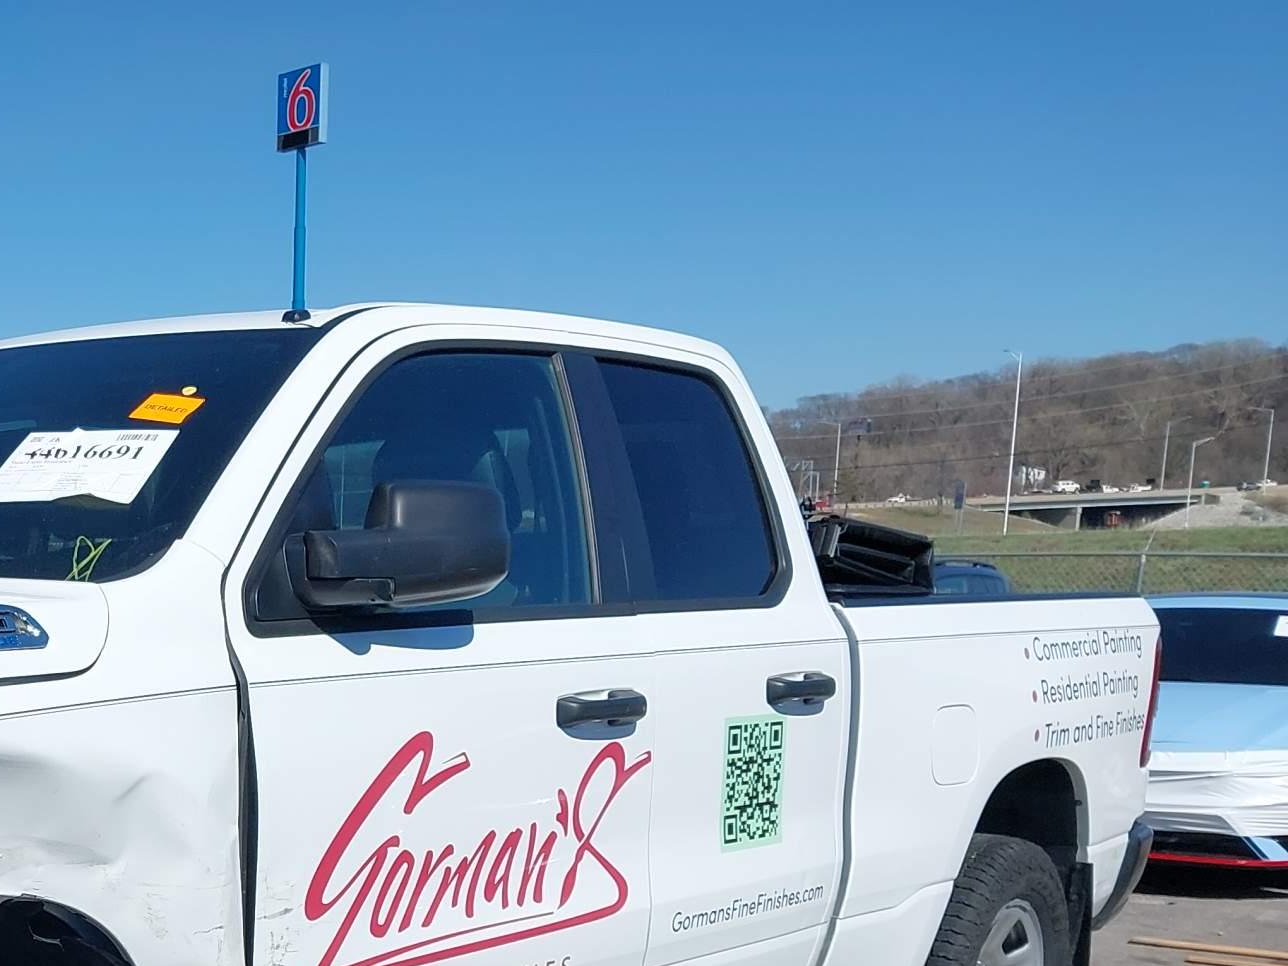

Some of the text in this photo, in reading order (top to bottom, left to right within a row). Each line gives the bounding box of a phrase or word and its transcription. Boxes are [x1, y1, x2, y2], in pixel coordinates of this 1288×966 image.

[286, 68, 316, 132] 6
[1032, 629, 1142, 661] Commercial Painting
[1040, 669, 1139, 704] Residential Painting
[1045, 708, 1145, 749] Trim and Fine Finishes
[671, 885, 824, 933] GormansFineFinishes.com
